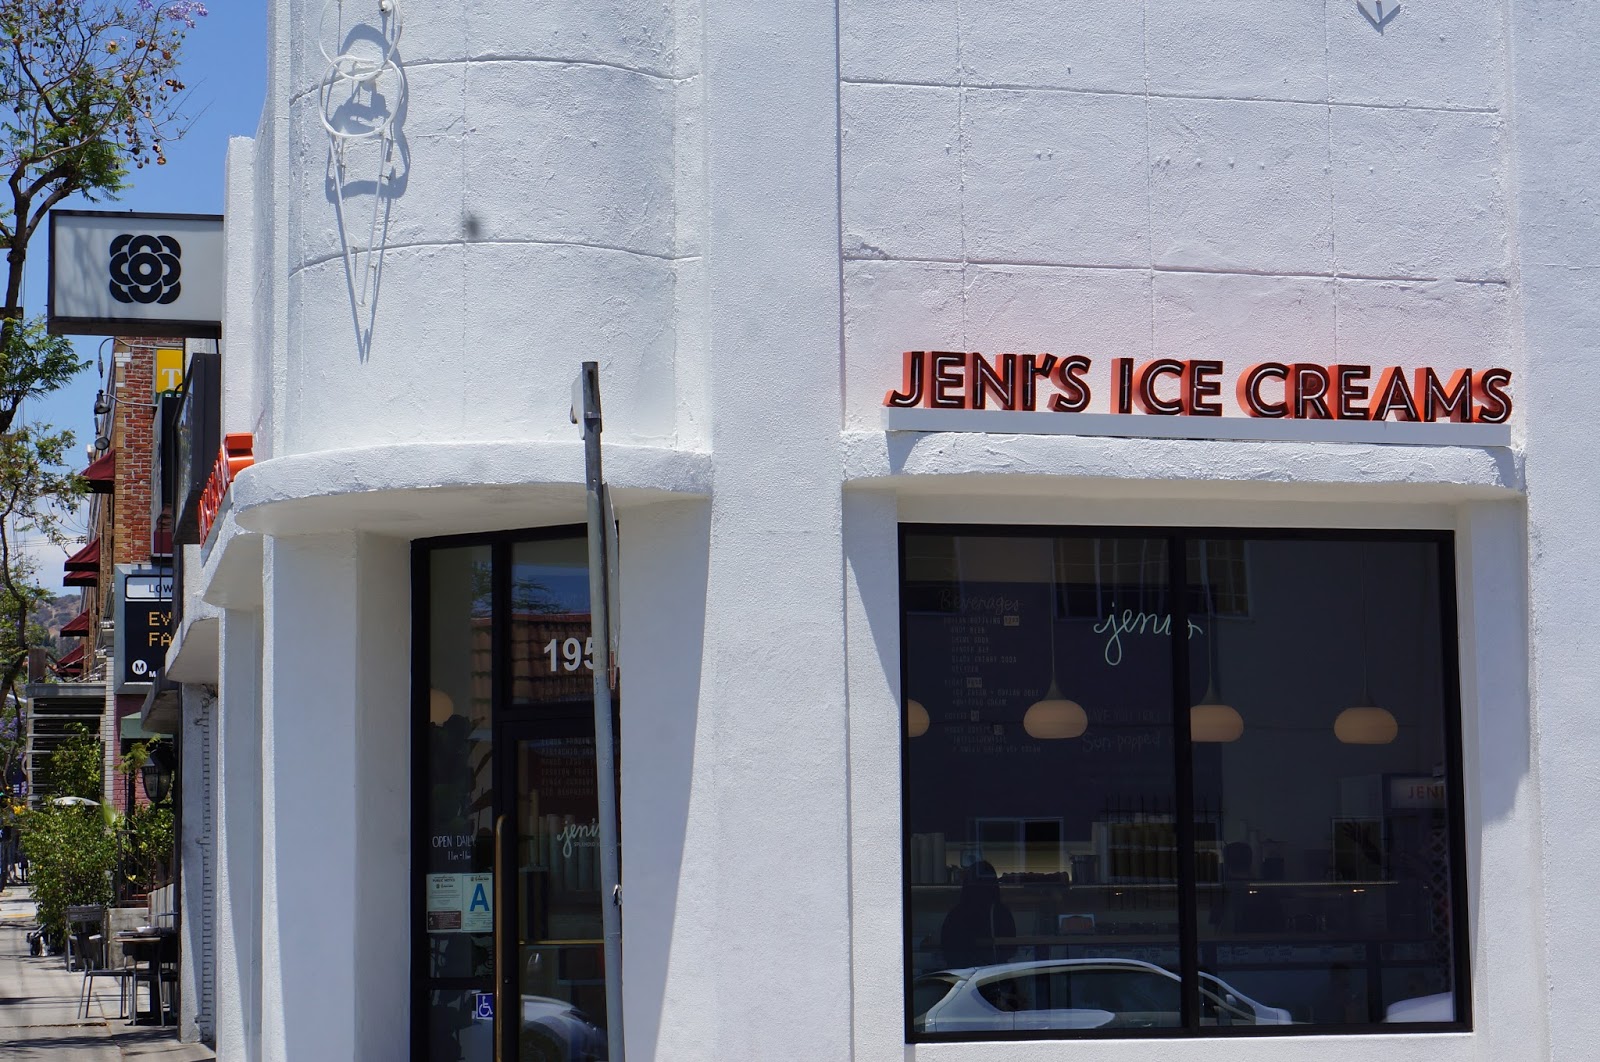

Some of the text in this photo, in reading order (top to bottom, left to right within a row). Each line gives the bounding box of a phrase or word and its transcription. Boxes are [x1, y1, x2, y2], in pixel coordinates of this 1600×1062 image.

[888, 351, 1512, 424] JENI'S ICE CREAMS
[432, 835, 477, 848] OPEN DAILY
[470, 883, 490, 912] A
